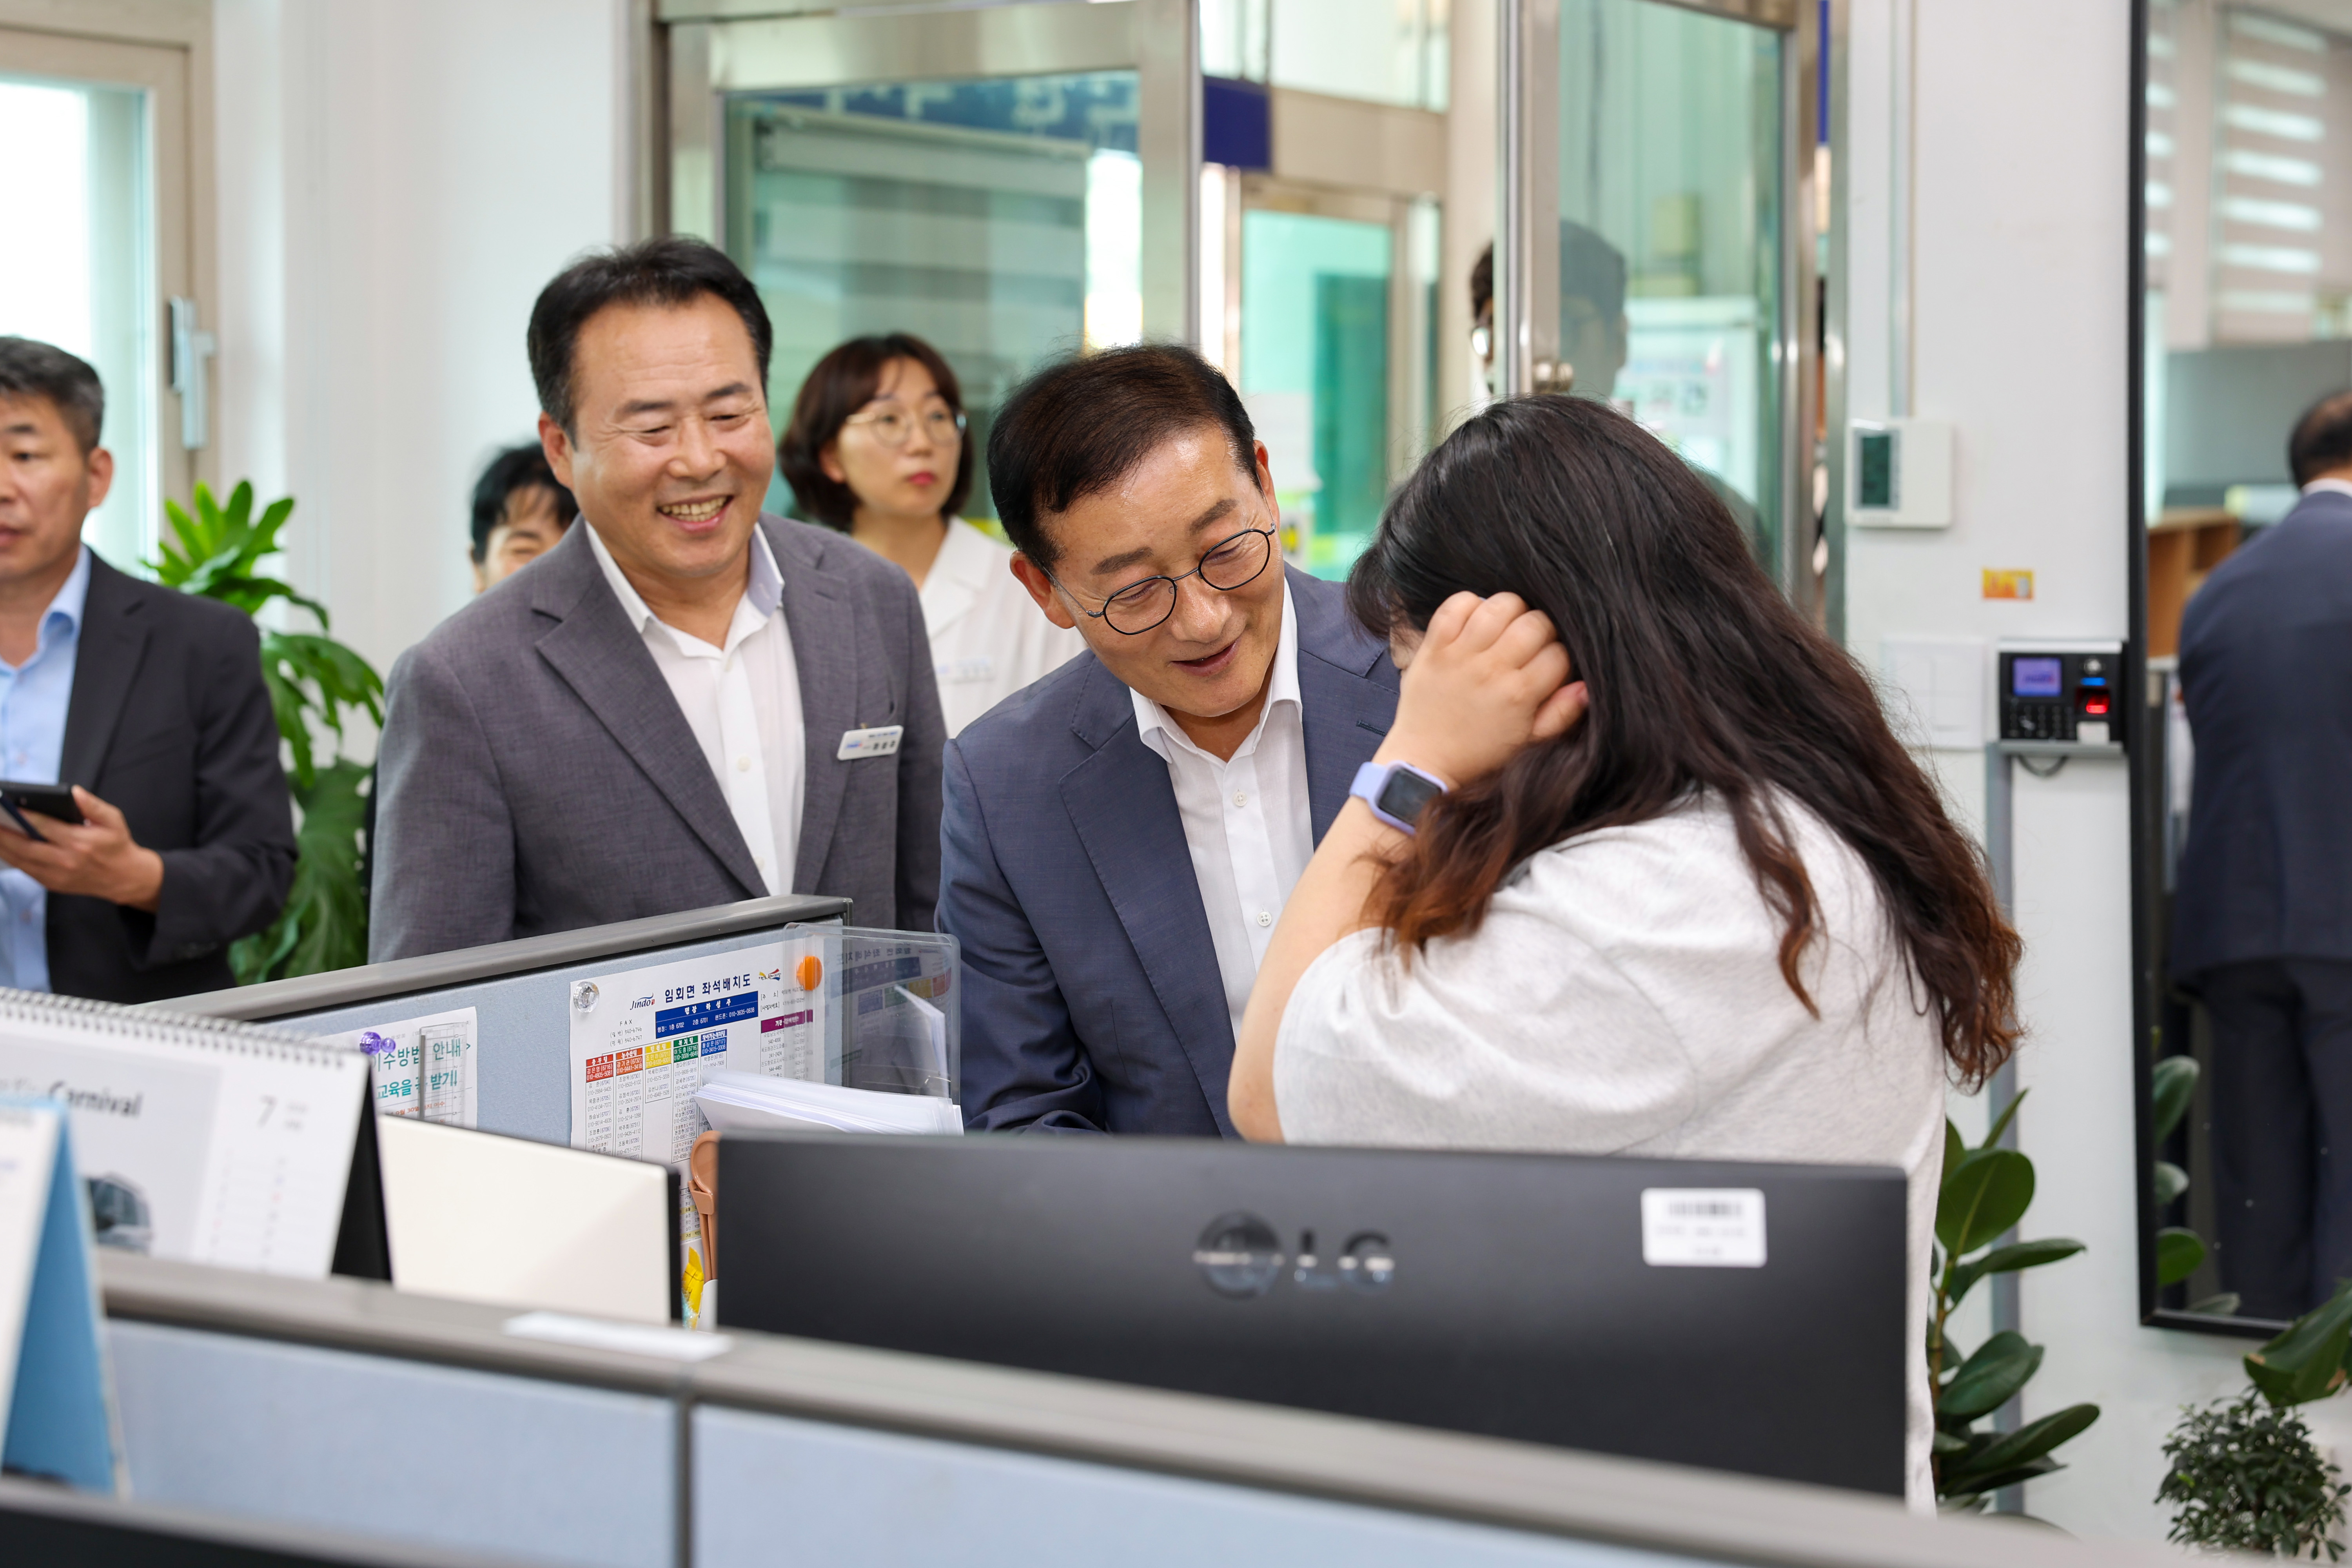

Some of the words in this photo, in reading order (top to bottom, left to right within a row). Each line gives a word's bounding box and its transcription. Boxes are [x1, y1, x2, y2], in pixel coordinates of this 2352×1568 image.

[665, 985, 694, 1003] 임회면
[702, 974, 750, 995] 좌석배치도
[630, 999, 651, 1010] Jindo
[625, 1026, 642, 1034] 540-6746
[434, 1038, 460, 1060] 안내
[377, 1079, 412, 1099] 교육을
[588, 1102, 612, 1112] 010-4134-7072
[618, 1096, 641, 1105] 010-3524-2974
[1294, 1228, 1395, 1290] LG
